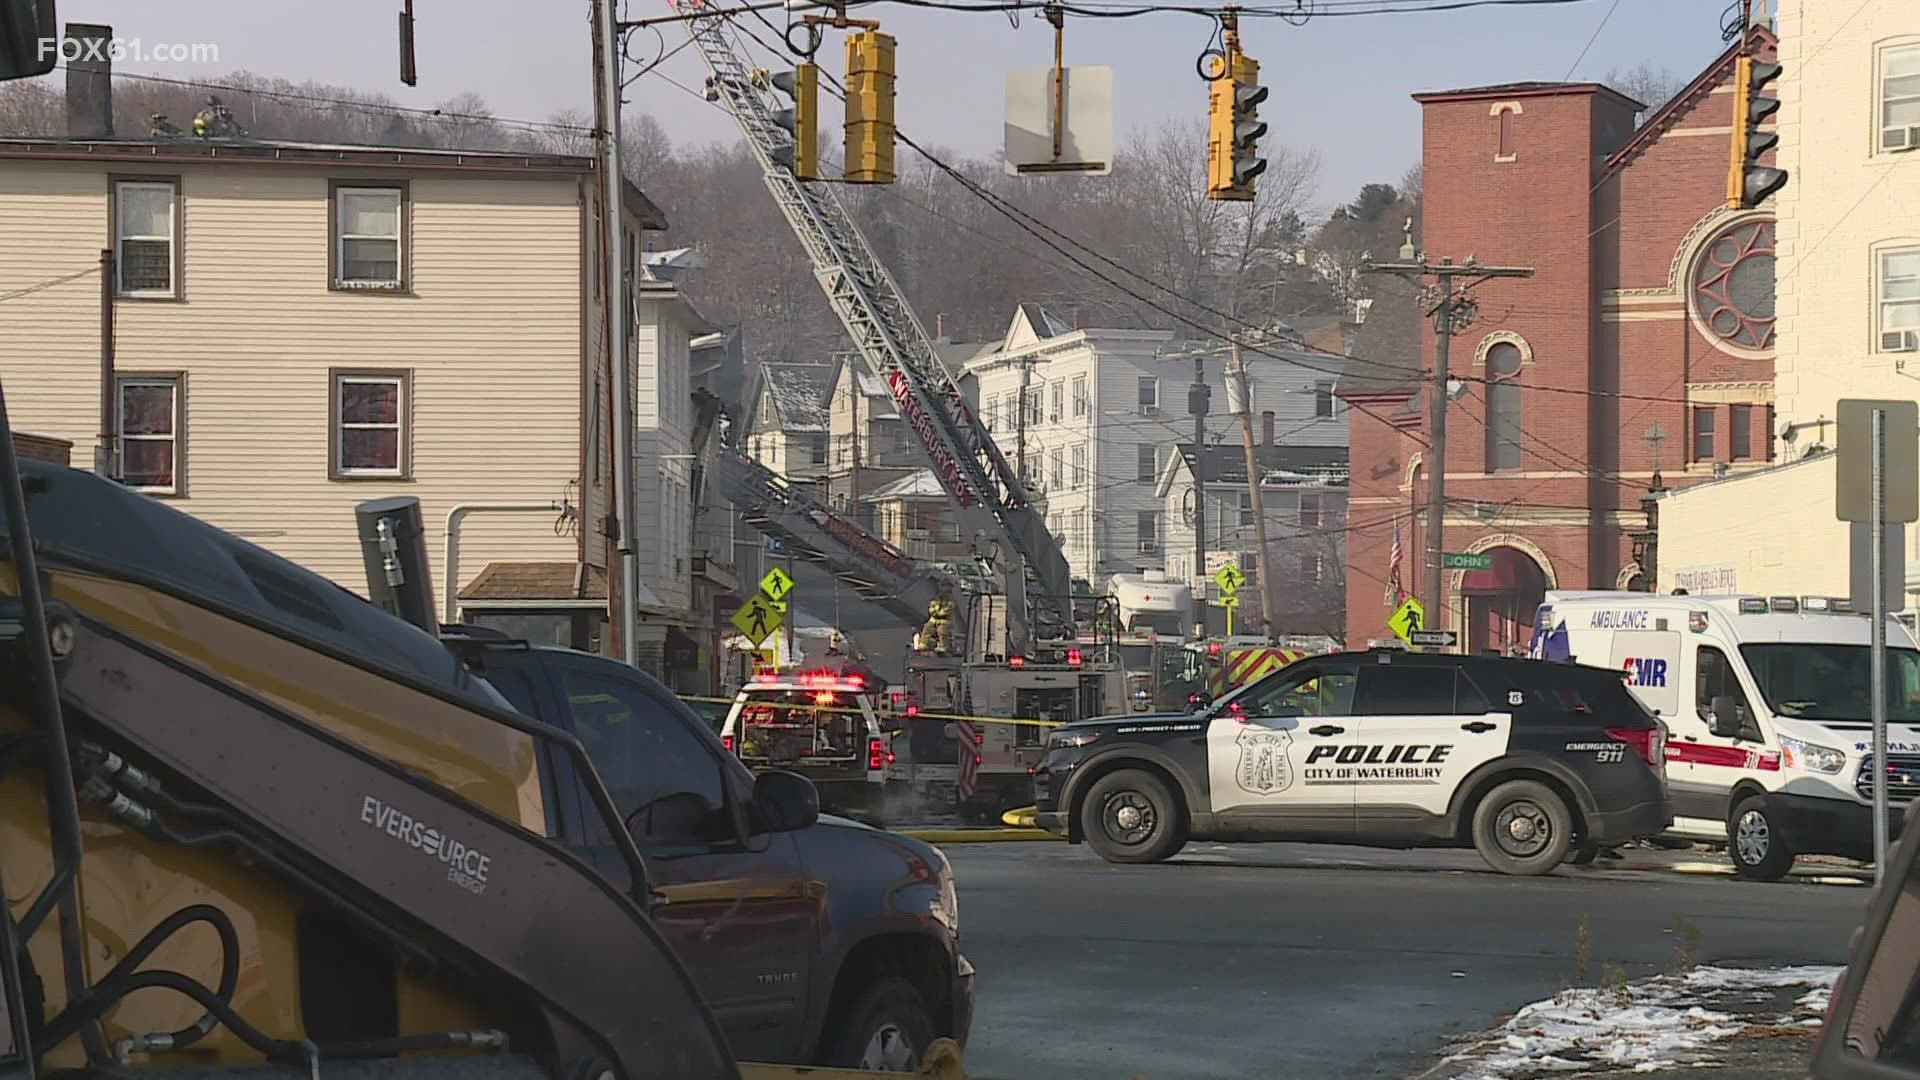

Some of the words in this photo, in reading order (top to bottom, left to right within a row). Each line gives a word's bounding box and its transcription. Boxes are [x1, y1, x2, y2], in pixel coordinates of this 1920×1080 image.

[893, 370, 951, 470] WATERBURY
[1446, 555, 1481, 567] JOHN
[1590, 610, 1648, 629] AMBULANCE
[1622, 657, 1667, 687] AMR
[1304, 744, 1455, 764] POLICE
[1566, 742, 1628, 751] EMERGENCY
[1595, 750, 1624, 763] 911
[1304, 768, 1333, 779] CITY
[1336, 768, 1355, 779] OF
[1357, 767, 1443, 778] WATERBURY
[361, 795, 491, 881] EVERSOURCE
[447, 867, 487, 895] ENERGY
